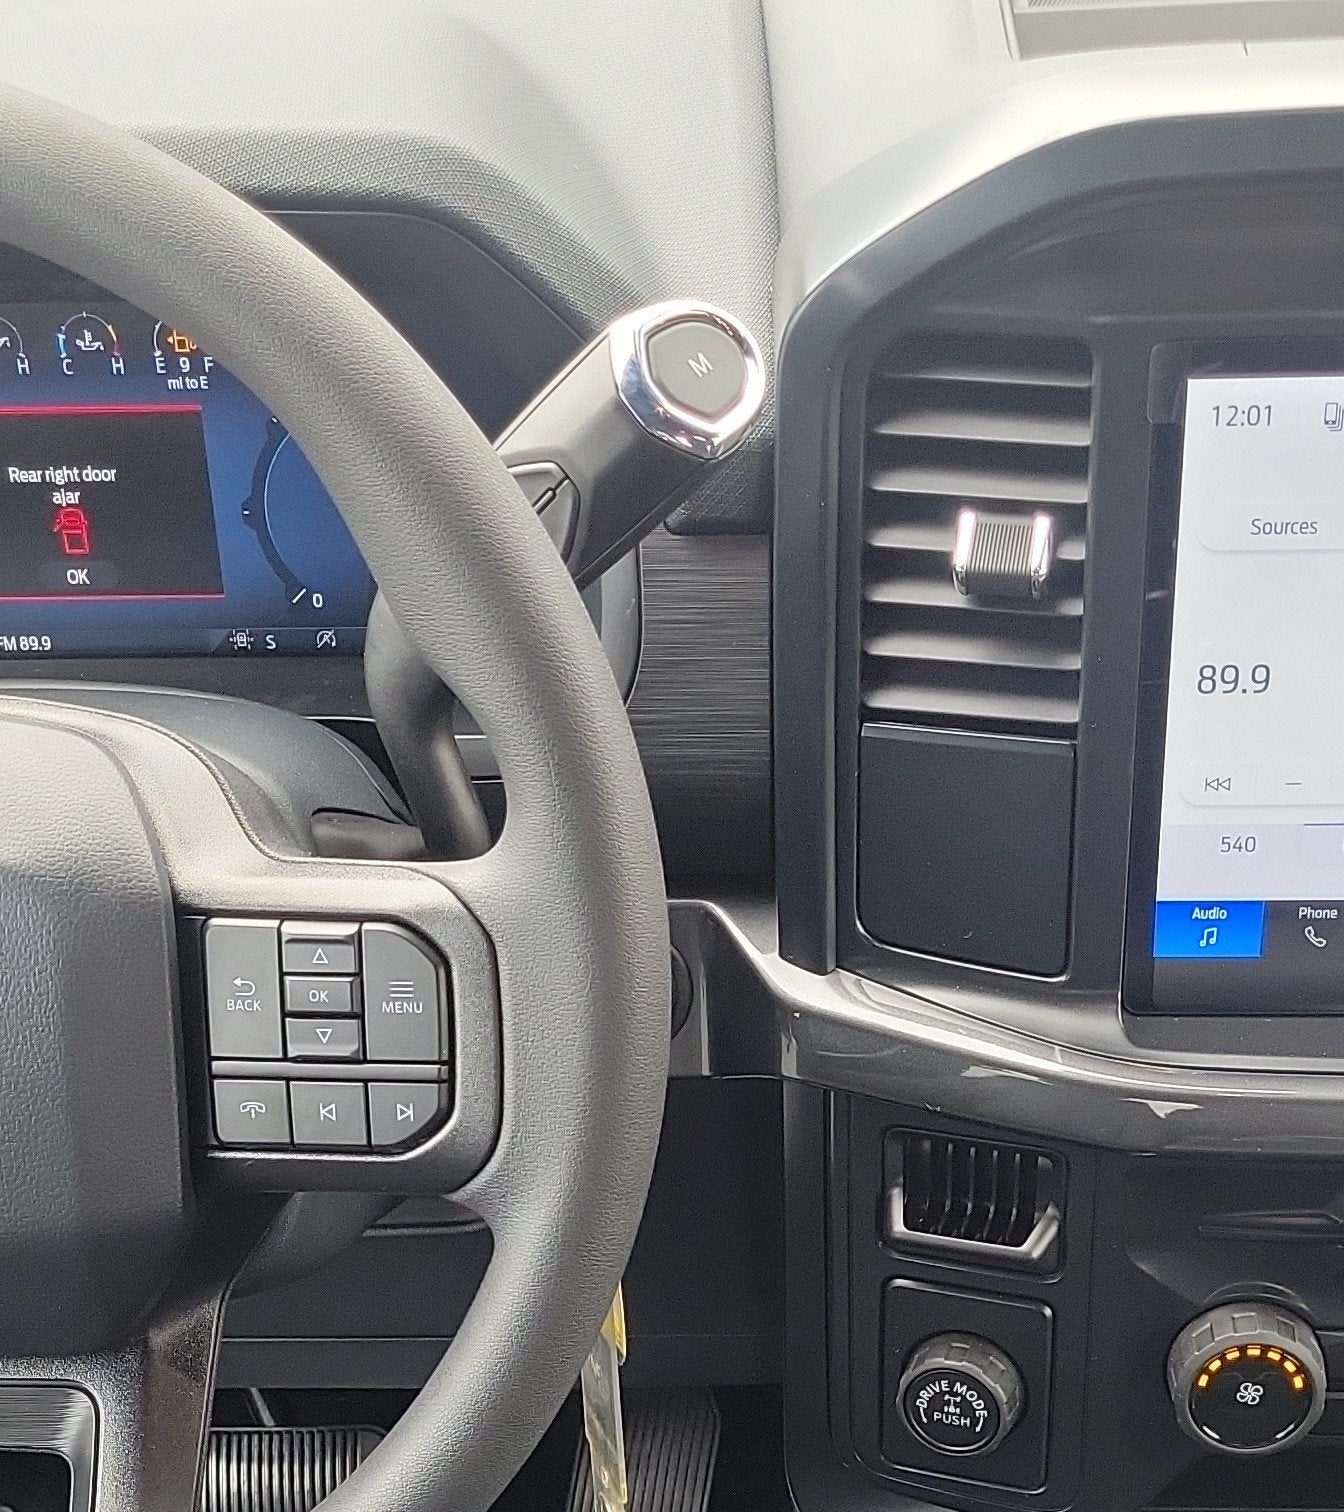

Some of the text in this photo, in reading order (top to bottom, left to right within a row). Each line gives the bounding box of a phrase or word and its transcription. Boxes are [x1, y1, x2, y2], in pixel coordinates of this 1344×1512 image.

[17, 358, 30, 375] H
[62, 359, 74, 376] C
[112, 358, 124, 375] H
[156, 357, 214, 374] E 9 F
[185, 376, 198, 390] to
[199, 376, 209, 390] E
[1211, 404, 1275, 428] 12:01
[8, 465, 117, 487] Rear right door
[52, 488, 81, 507] ajar
[1249, 516, 1318, 537] Sources
[66, 568, 91, 585] OK
[312, 593, 323, 608] 0
[19, 635, 52, 651] 89.9
[264, 634, 277, 650] S
[1196, 663, 1272, 696] 89.9
[1219, 835, 1258, 854] 540
[1190, 905, 1228, 921] Audio
[1297, 905, 1339, 920] Phone
[226, 998, 263, 1012] BACK
[308, 989, 330, 1004] OK
[381, 1001, 424, 1014] MENU
[916, 1380, 988, 1418] DRIVE MODE
[933, 1411, 971, 1428] PUSH
